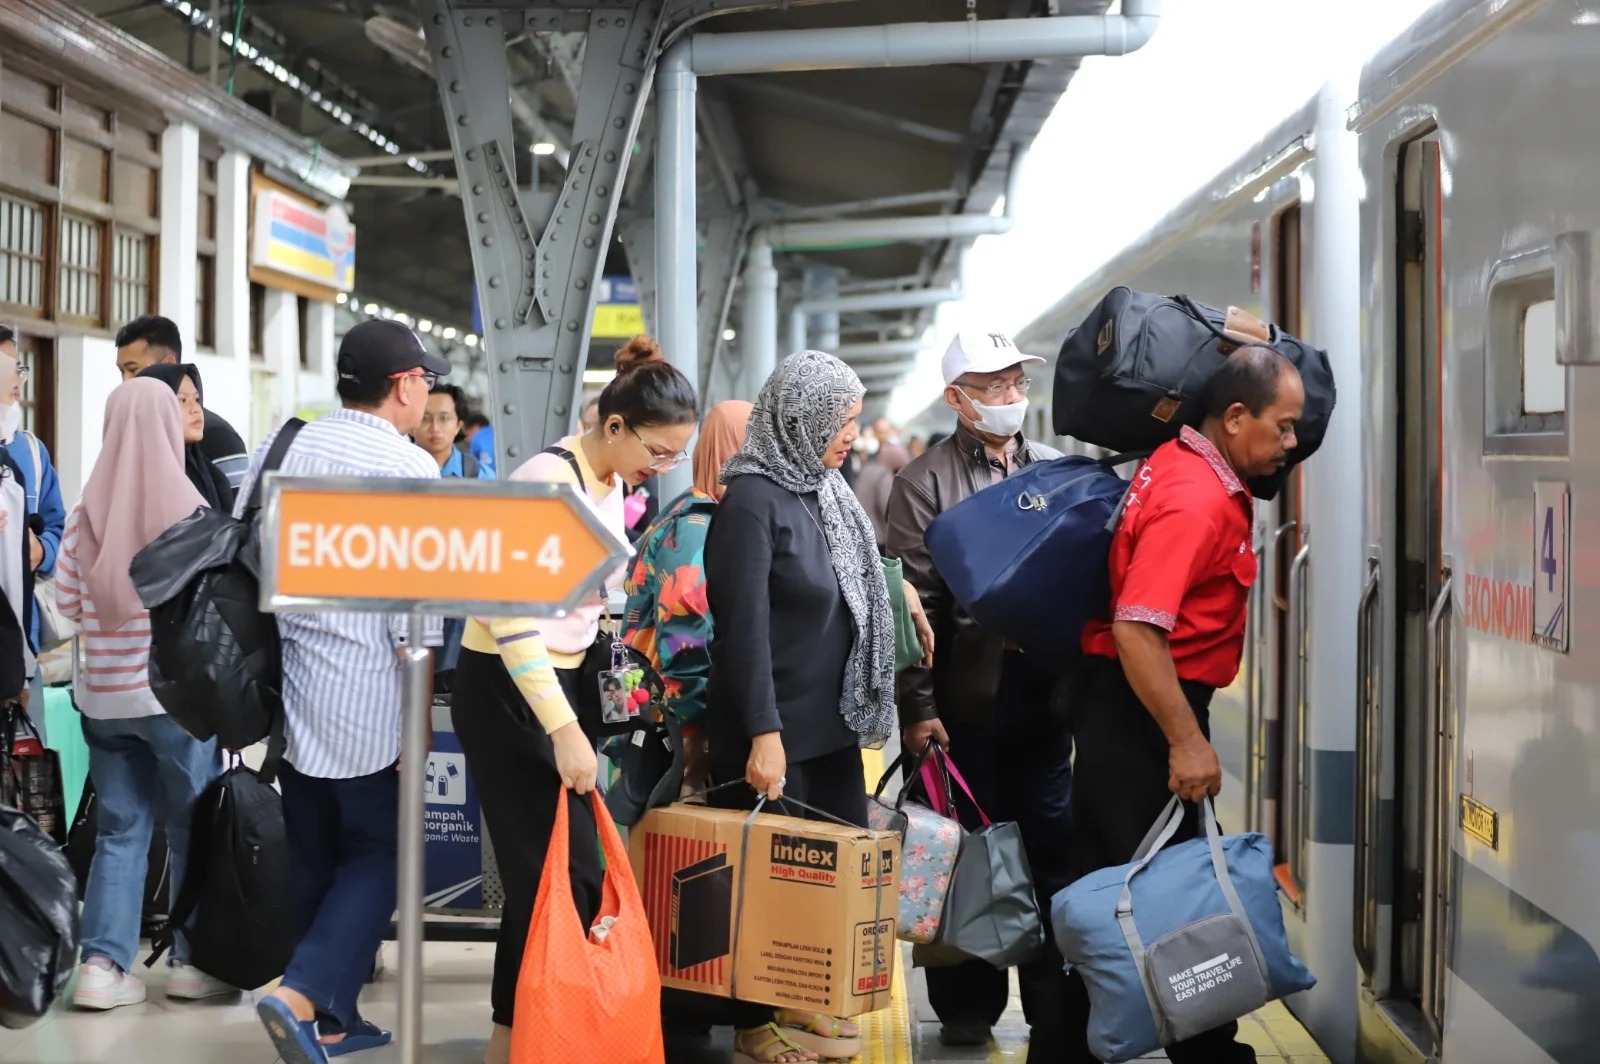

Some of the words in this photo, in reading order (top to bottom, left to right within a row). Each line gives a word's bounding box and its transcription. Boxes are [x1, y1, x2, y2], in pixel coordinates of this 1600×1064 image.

[288, 522, 502, 574] EKONOMI
[511, 549, 528, 561] -
[536, 533, 564, 576] 4
[1541, 506, 1556, 593] 4
[1464, 571, 1533, 645] EKONOMI
[424, 810, 464, 822] ampah
[424, 833, 449, 842] ganic
[451, 833, 480, 843] Waste
[773, 838, 834, 867] index
[771, 865, 795, 877] High
[798, 869, 836, 883] Quality
[1168, 968, 1193, 985] MAKE
[1171, 977, 1196, 993] YOUR
[1194, 965, 1227, 983] TRAVEL
[1225, 956, 1243, 970] LIFE
[1175, 987, 1197, 1002] EASY
[1198, 979, 1216, 993] AND
[1216, 971, 1233, 985] FUN
